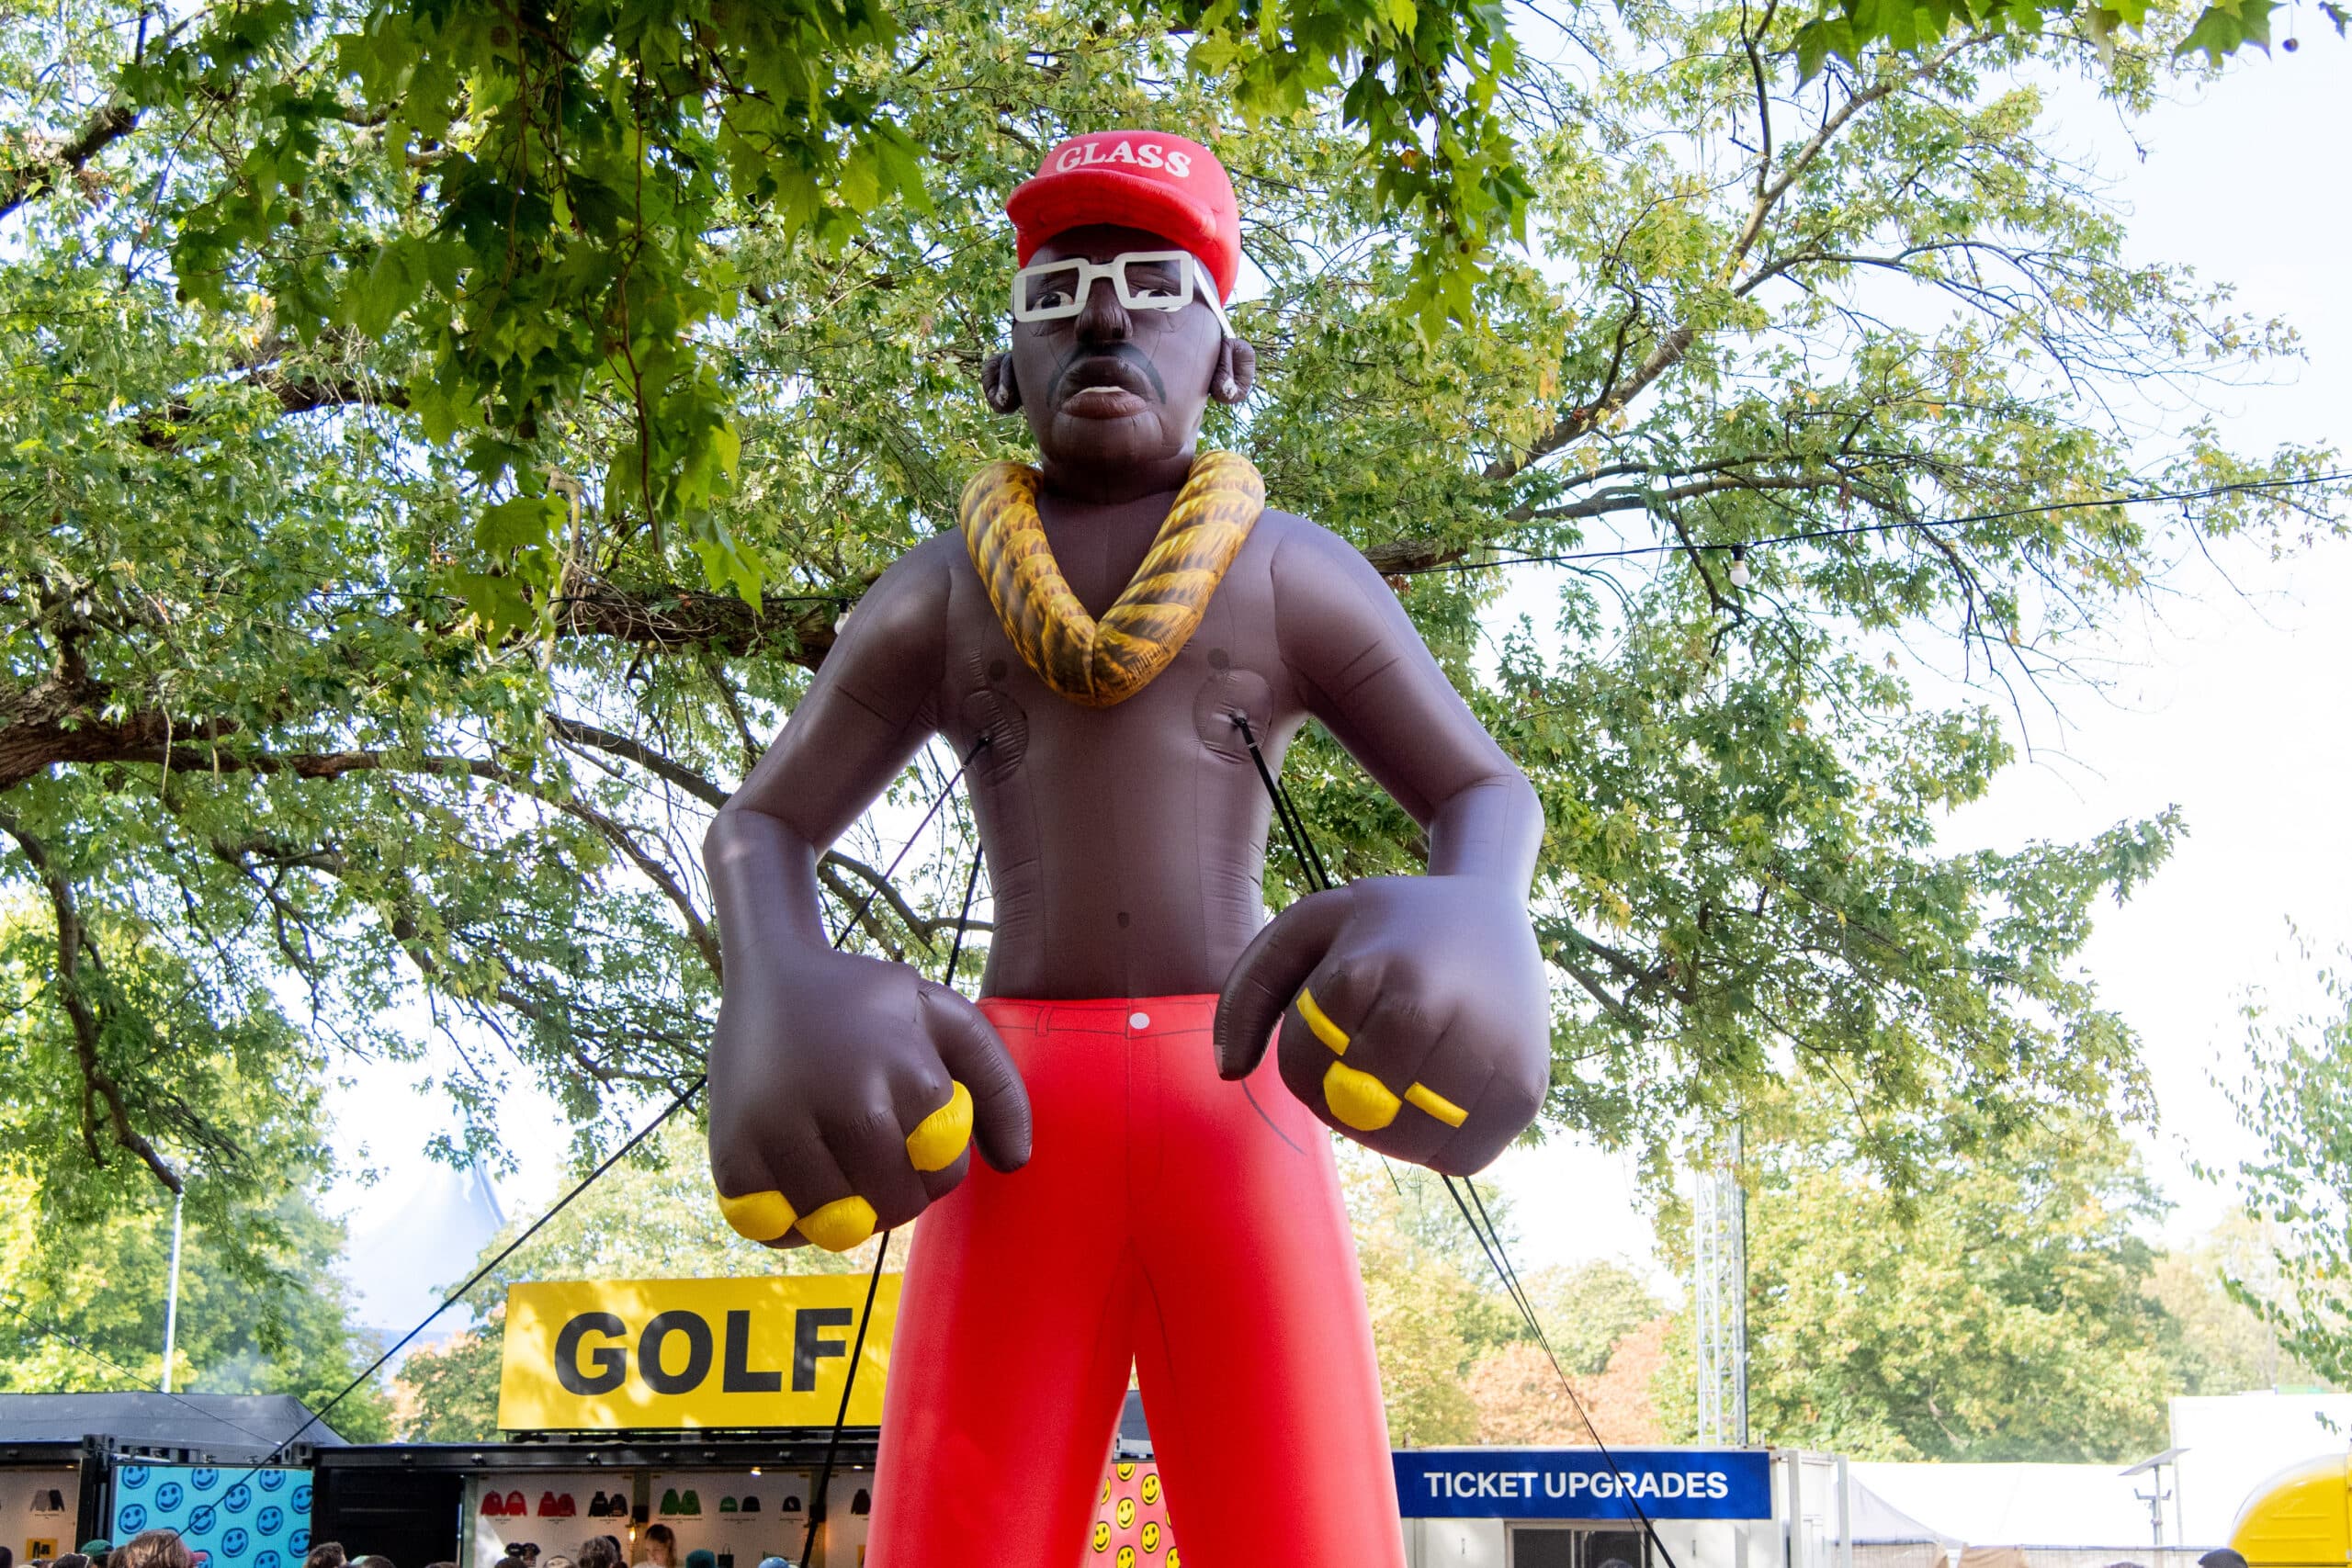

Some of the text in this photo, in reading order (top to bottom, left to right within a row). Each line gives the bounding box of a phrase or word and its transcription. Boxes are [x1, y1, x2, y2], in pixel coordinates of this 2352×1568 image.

[1057, 141, 1192, 178] GLASS
[554, 1307, 853, 1395] GOLF
[1423, 1472, 1729, 1499] TICKET UPGRADES
